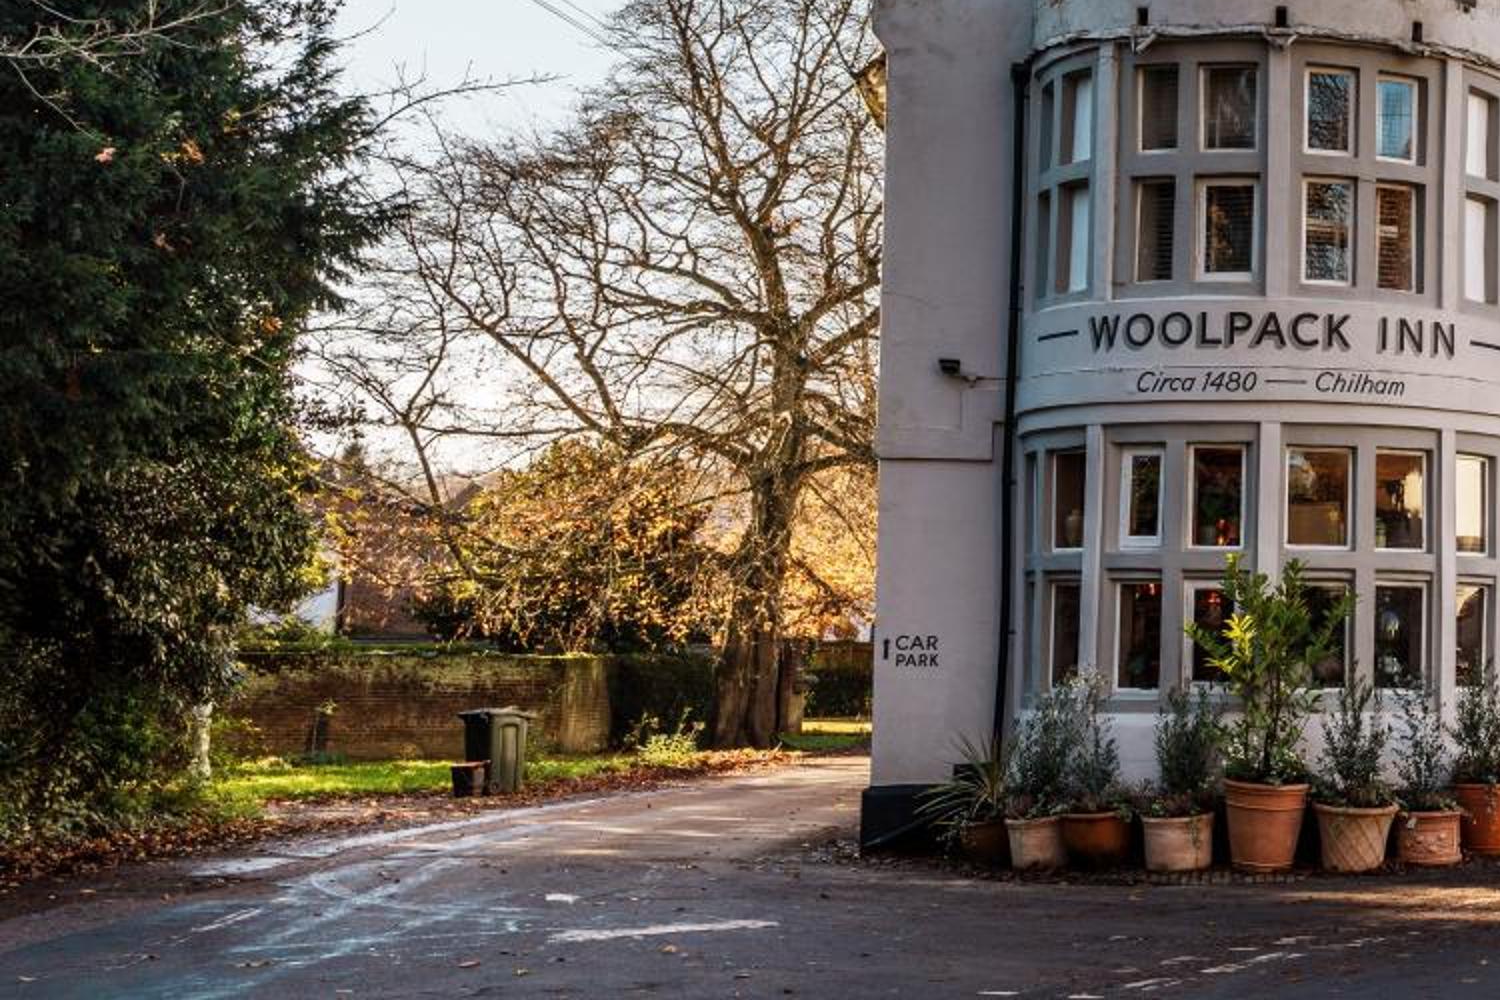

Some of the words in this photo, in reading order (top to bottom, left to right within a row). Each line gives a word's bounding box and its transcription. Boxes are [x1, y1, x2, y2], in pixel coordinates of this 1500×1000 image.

[1088, 311, 1351, 350] WOOLPACK
[1376, 316, 1455, 358] INN
[1136, 371, 1196, 393] Circa
[1201, 371, 1258, 393] 1480
[1315, 373, 1405, 396] Chilham
[895, 634, 939, 651] CAR
[895, 653, 939, 667] PARK
